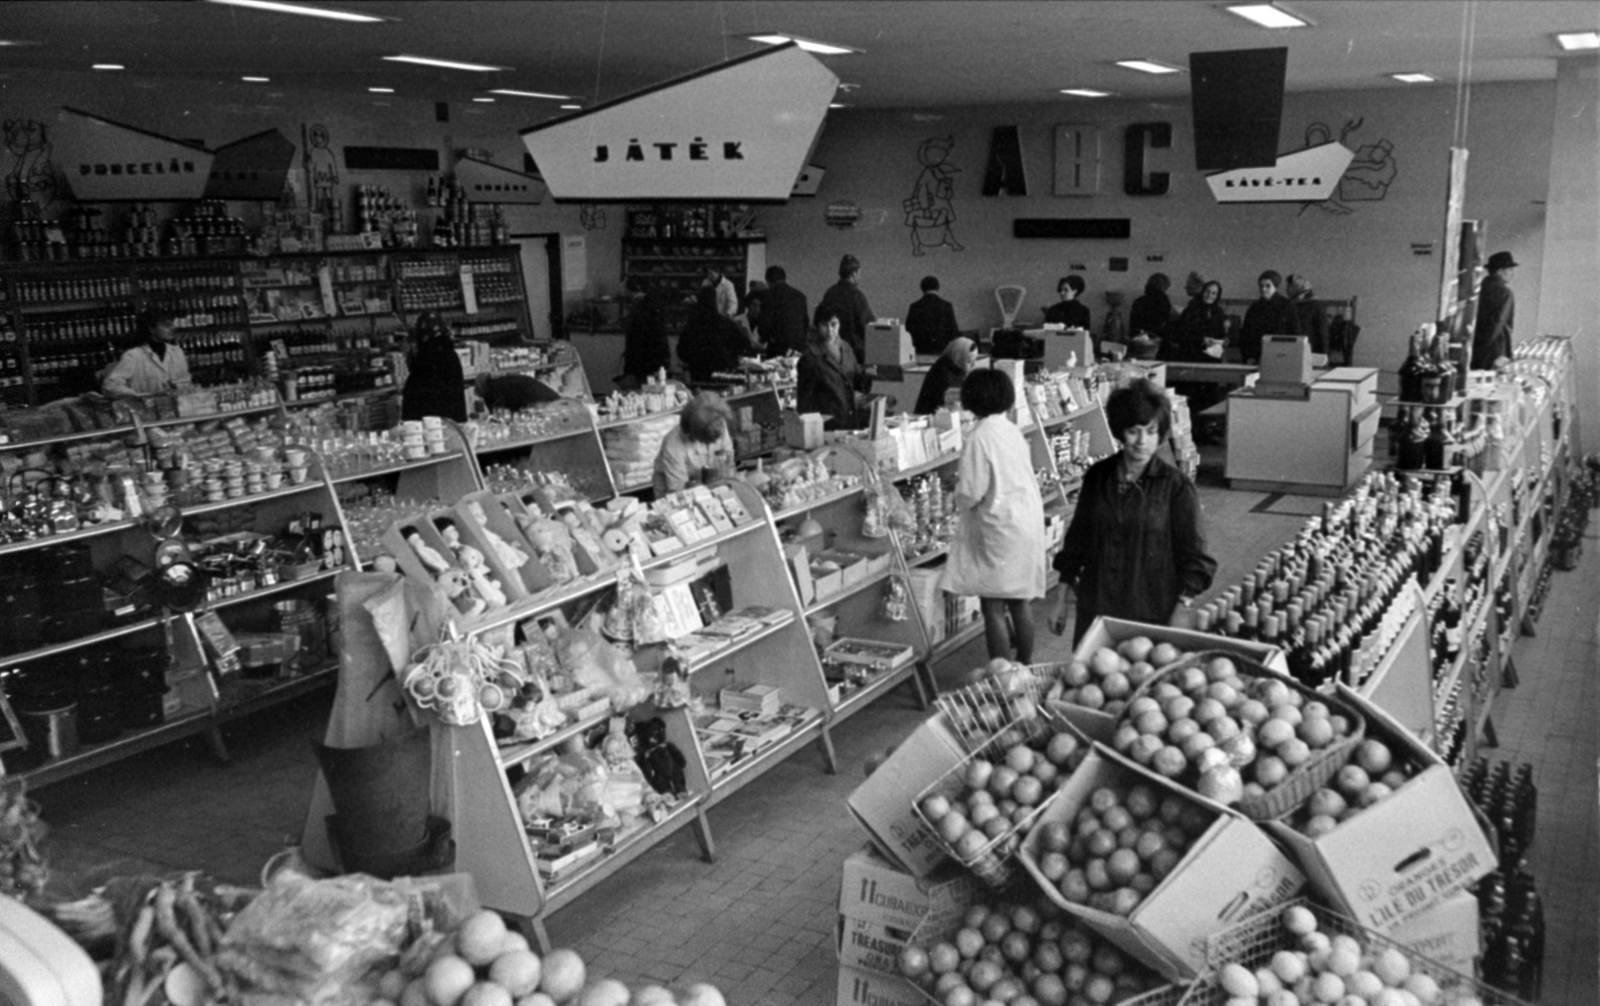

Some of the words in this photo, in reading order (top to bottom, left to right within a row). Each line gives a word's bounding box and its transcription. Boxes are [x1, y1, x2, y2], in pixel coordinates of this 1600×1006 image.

[594, 136, 743, 162] JÁTÉK
[982, 121, 1172, 199] ABC
[1404, 886, 1427, 907] DU
